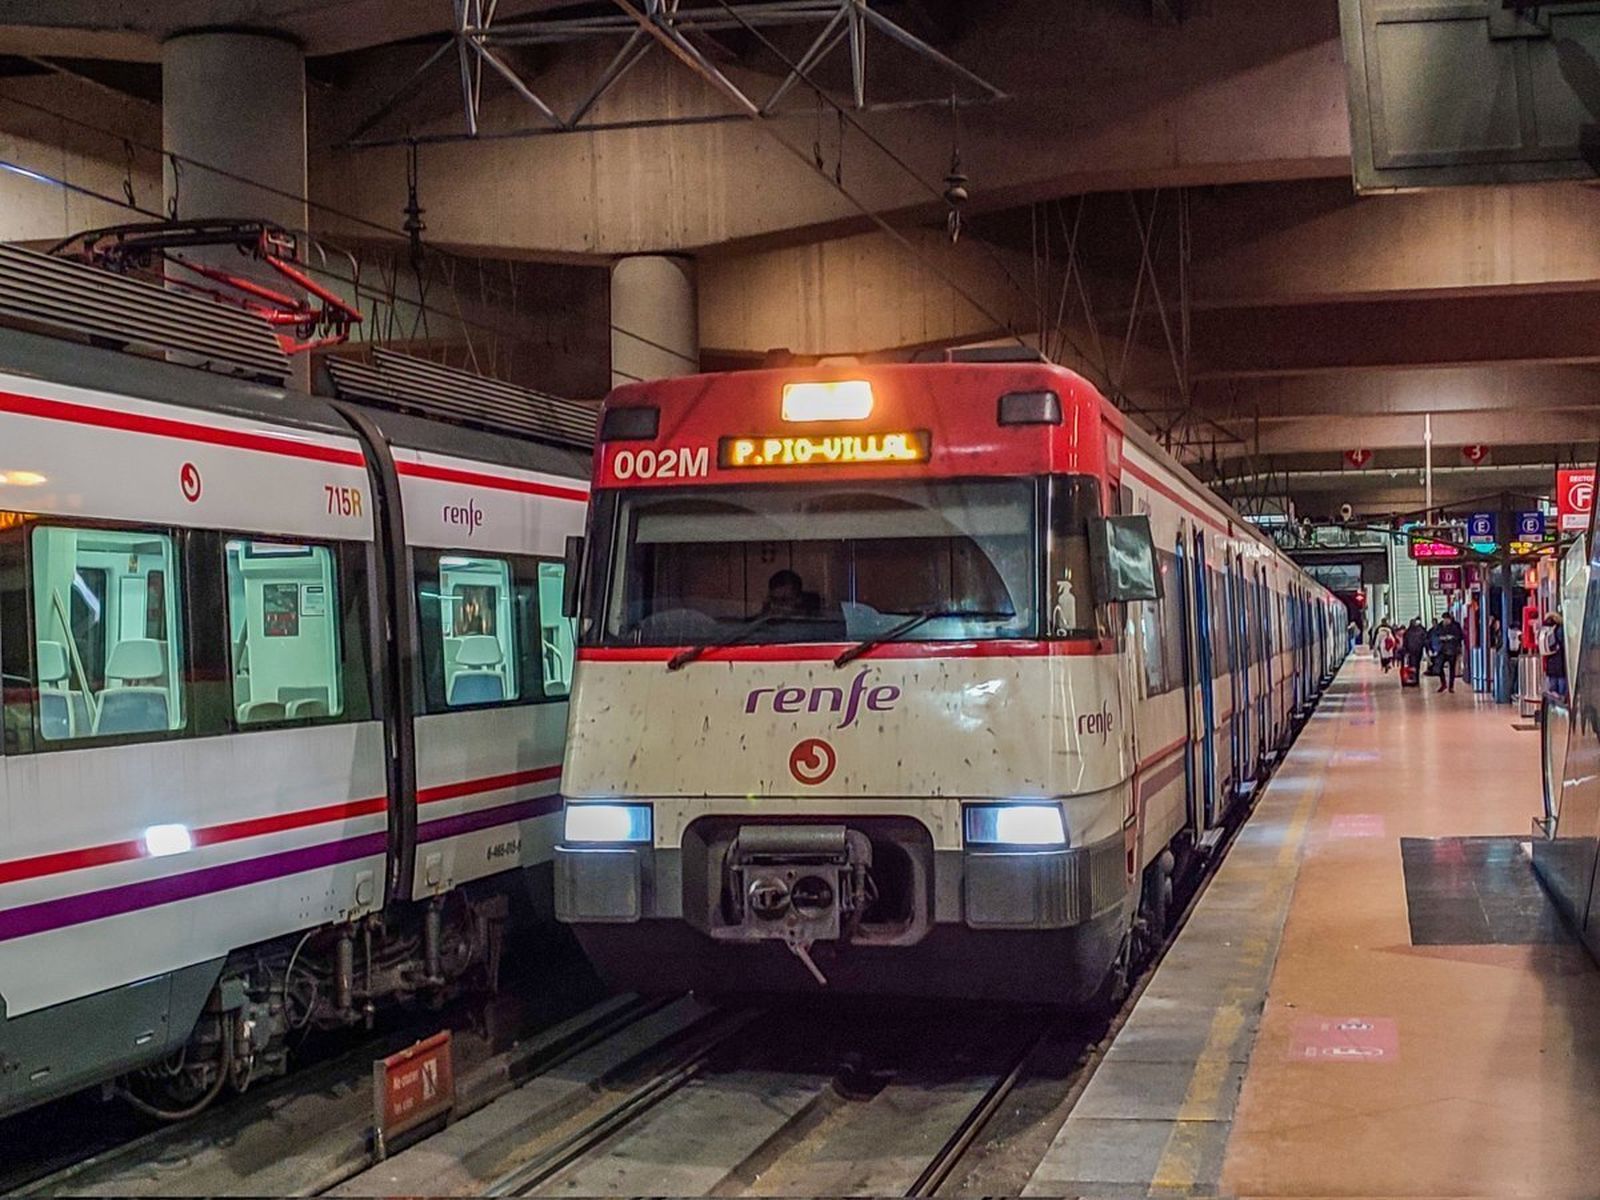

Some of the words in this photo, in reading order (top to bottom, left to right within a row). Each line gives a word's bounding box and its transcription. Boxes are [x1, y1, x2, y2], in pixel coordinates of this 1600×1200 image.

[613, 447, 709, 480] 002M
[1351, 448, 1362, 462] 4
[1471, 444, 1481, 460] 3
[324, 485, 362, 517] 715R
[1577, 486, 1592, 507] F
[443, 498, 483, 536] renfe
[1477, 521, 1485, 533] E
[1527, 520, 1535, 532] E
[744, 668, 901, 729] renfe
[1078, 699, 1113, 746] renfe
